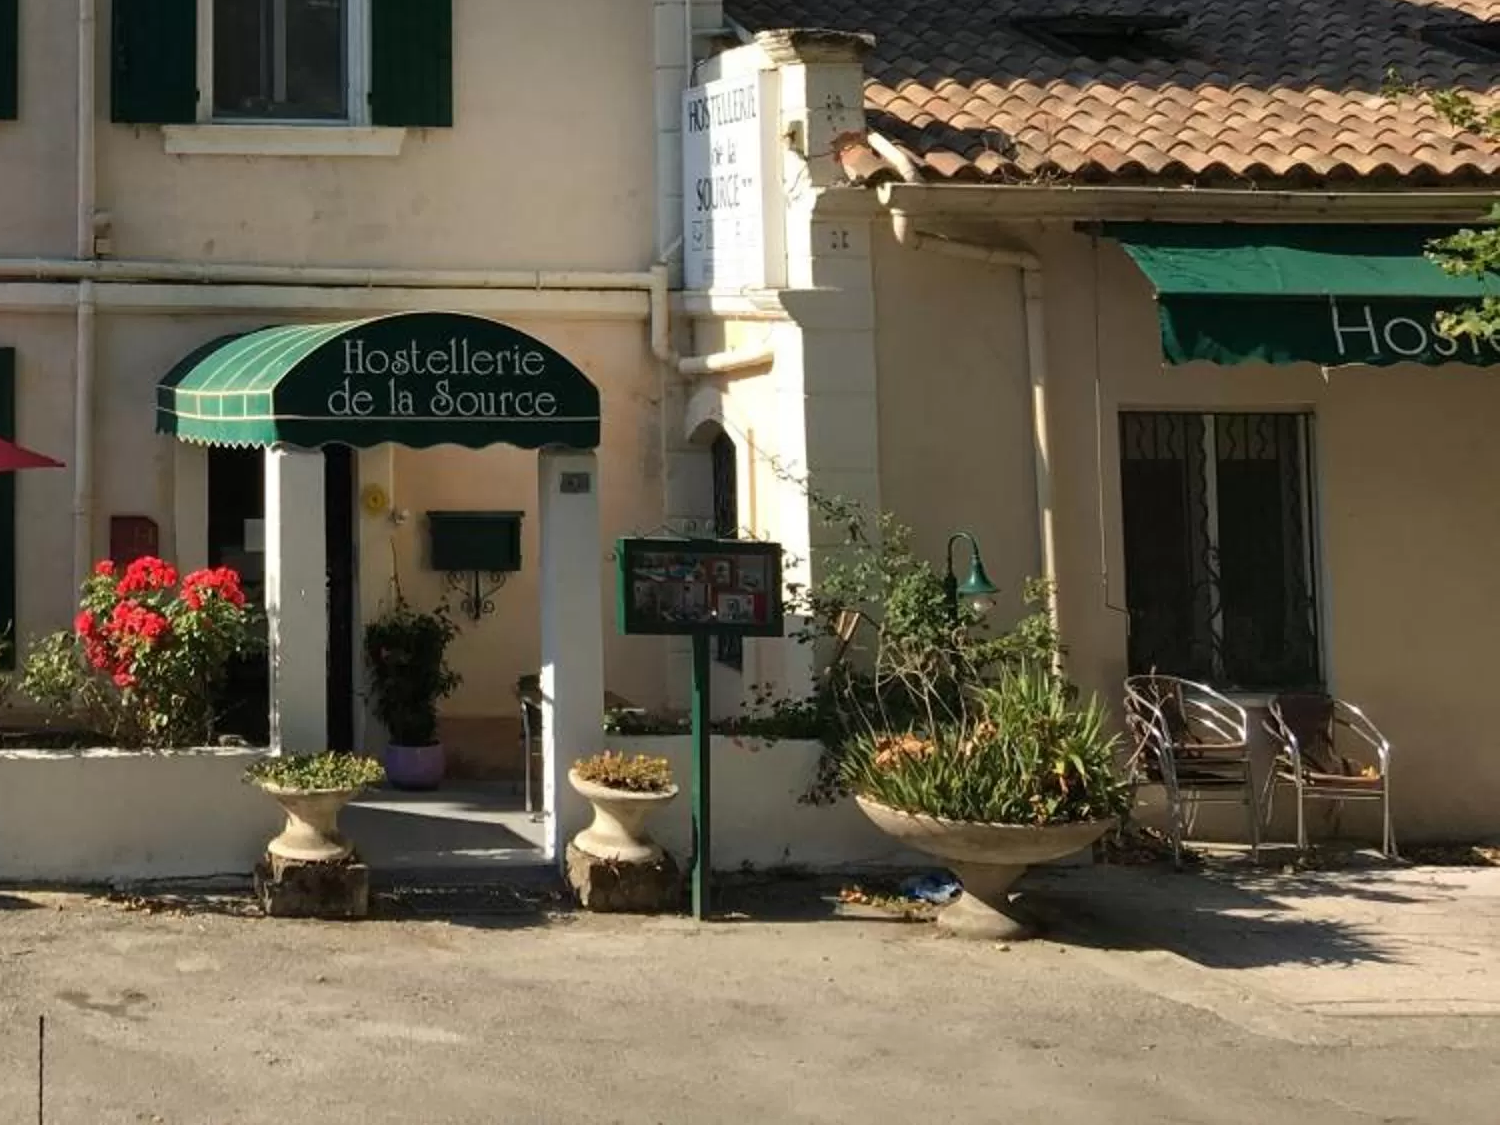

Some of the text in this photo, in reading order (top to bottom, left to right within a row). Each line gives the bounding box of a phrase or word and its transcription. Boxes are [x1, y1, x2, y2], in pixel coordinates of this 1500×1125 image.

[343, 339, 545, 375] Hostellerie
[328, 377, 558, 416] de la Source
